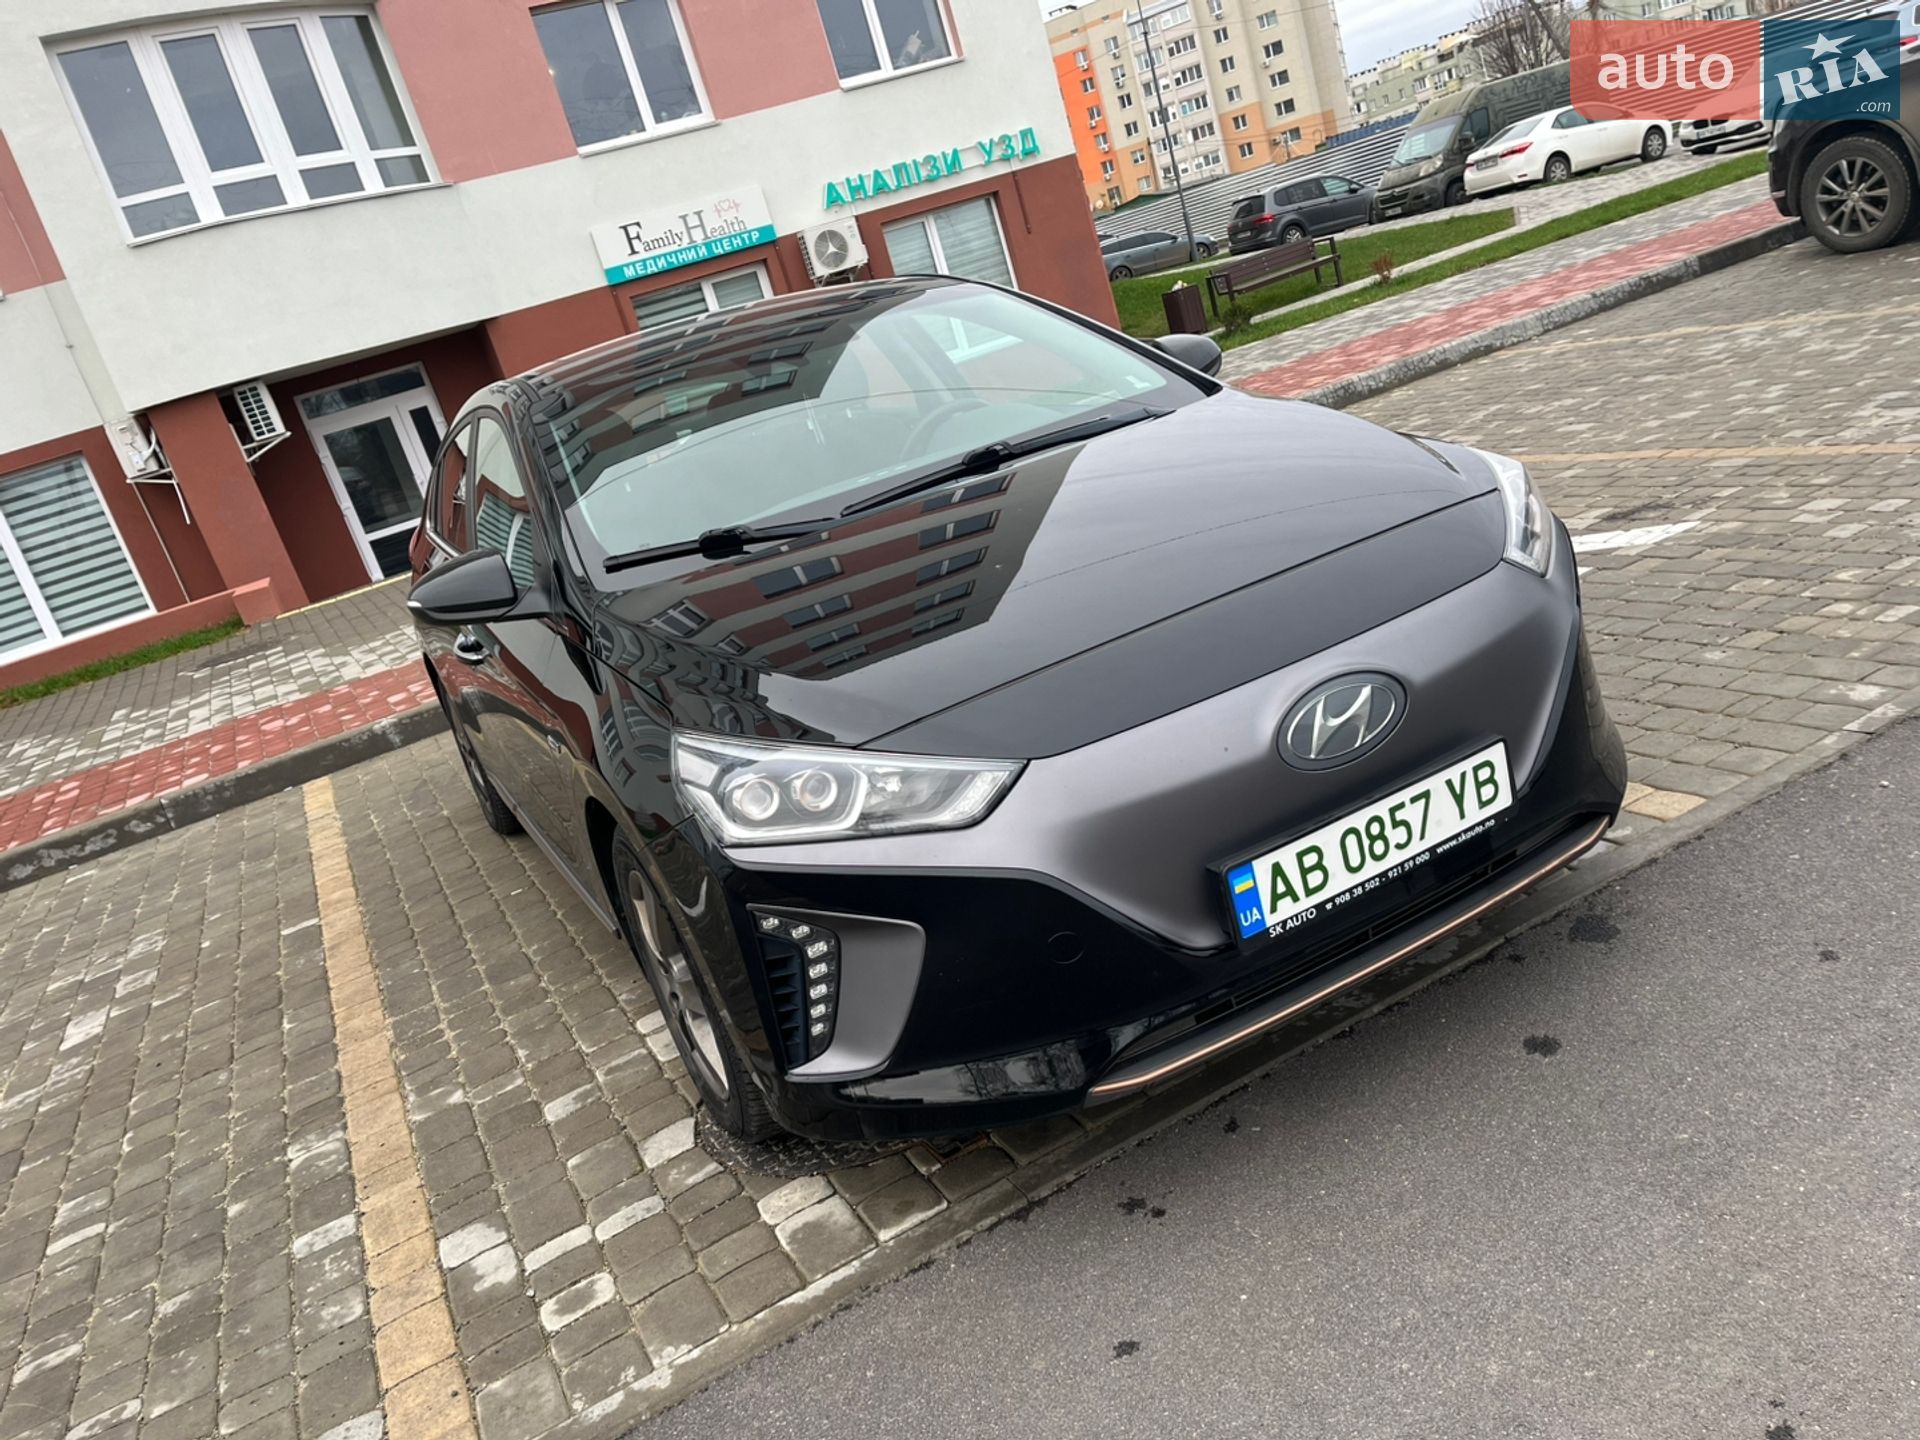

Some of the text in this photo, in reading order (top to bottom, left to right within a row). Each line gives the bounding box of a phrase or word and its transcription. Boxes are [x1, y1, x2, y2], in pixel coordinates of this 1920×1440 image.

[823, 127, 1041, 210] АНАЛІЗИ УЗД
[623, 230, 761, 279] МЕДИЧНИЙ ЦЕНТР
[1269, 759, 1500, 915] AB 0857 YB
[1240, 906, 1262, 927] UA
[1268, 923, 1284, 938] SK
[1285, 907, 1317, 931] AUTO
[1334, 892, 1351, 906] 908
[1352, 886, 1363, 898] 38
[1364, 877, 1380, 892] 502
[1387, 865, 1403, 880] 921
